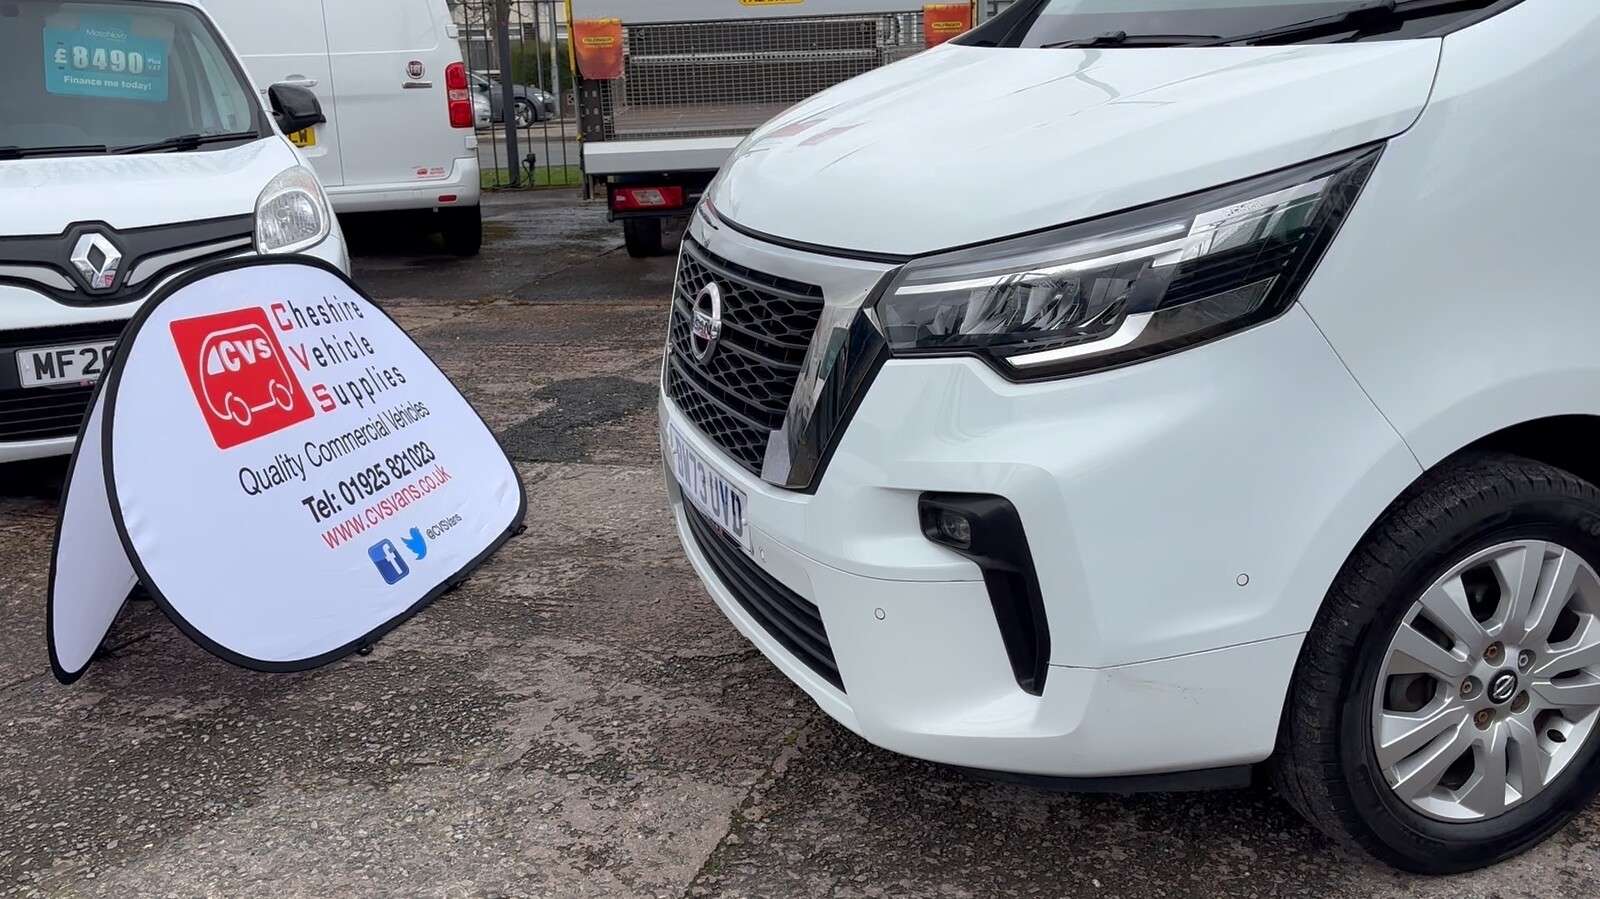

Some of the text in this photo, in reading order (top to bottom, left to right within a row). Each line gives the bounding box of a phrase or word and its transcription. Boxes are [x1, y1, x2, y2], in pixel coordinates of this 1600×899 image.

[64, 75, 152, 91] Finance me today!
[271, 296, 364, 331] Cheshire
[289, 331, 375, 371] Vehicle
[312, 364, 406, 413] Supplies
[239, 400, 430, 496] Quality Commercial Vehicles
[301, 440, 436, 524] Tel: 01925 821023
[321, 463, 453, 550] www.cvsvans.co.uk
